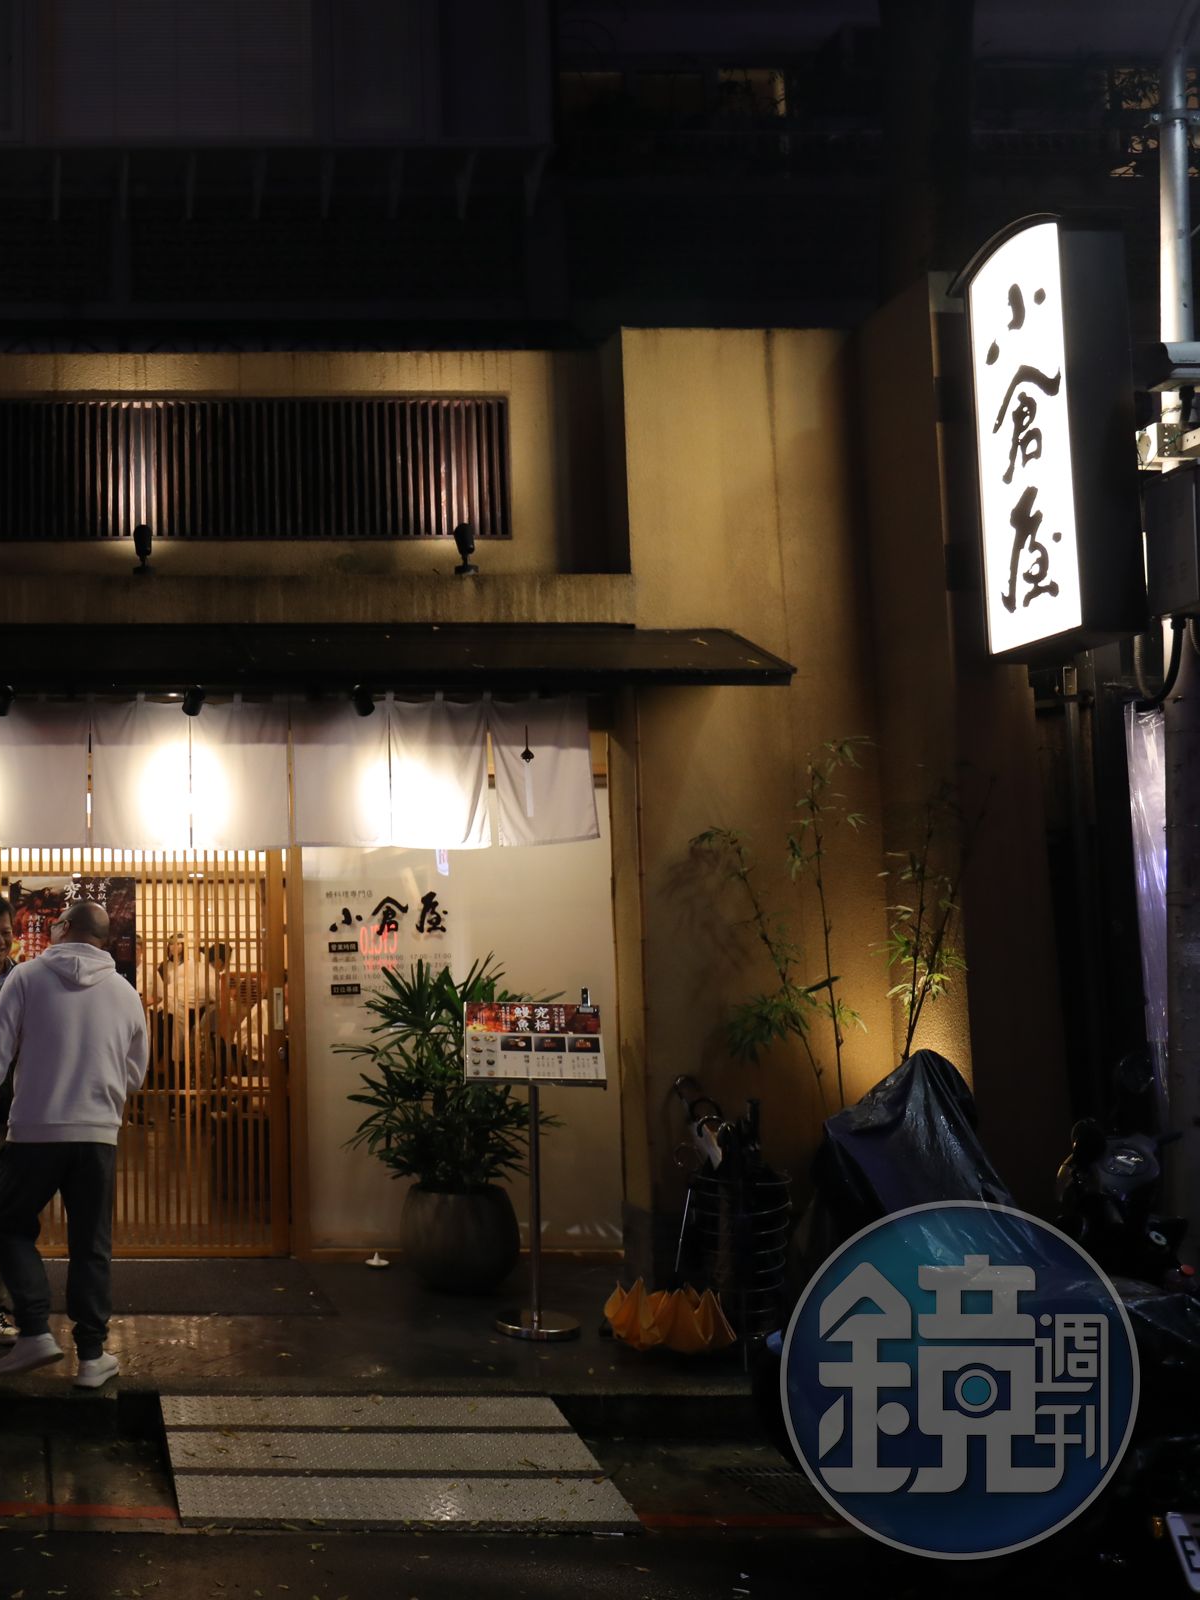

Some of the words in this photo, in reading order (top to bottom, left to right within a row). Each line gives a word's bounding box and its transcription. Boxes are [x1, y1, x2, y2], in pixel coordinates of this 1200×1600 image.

[986, 283, 1061, 613] 小倉屋
[329, 891, 448, 935] 小倉屋
